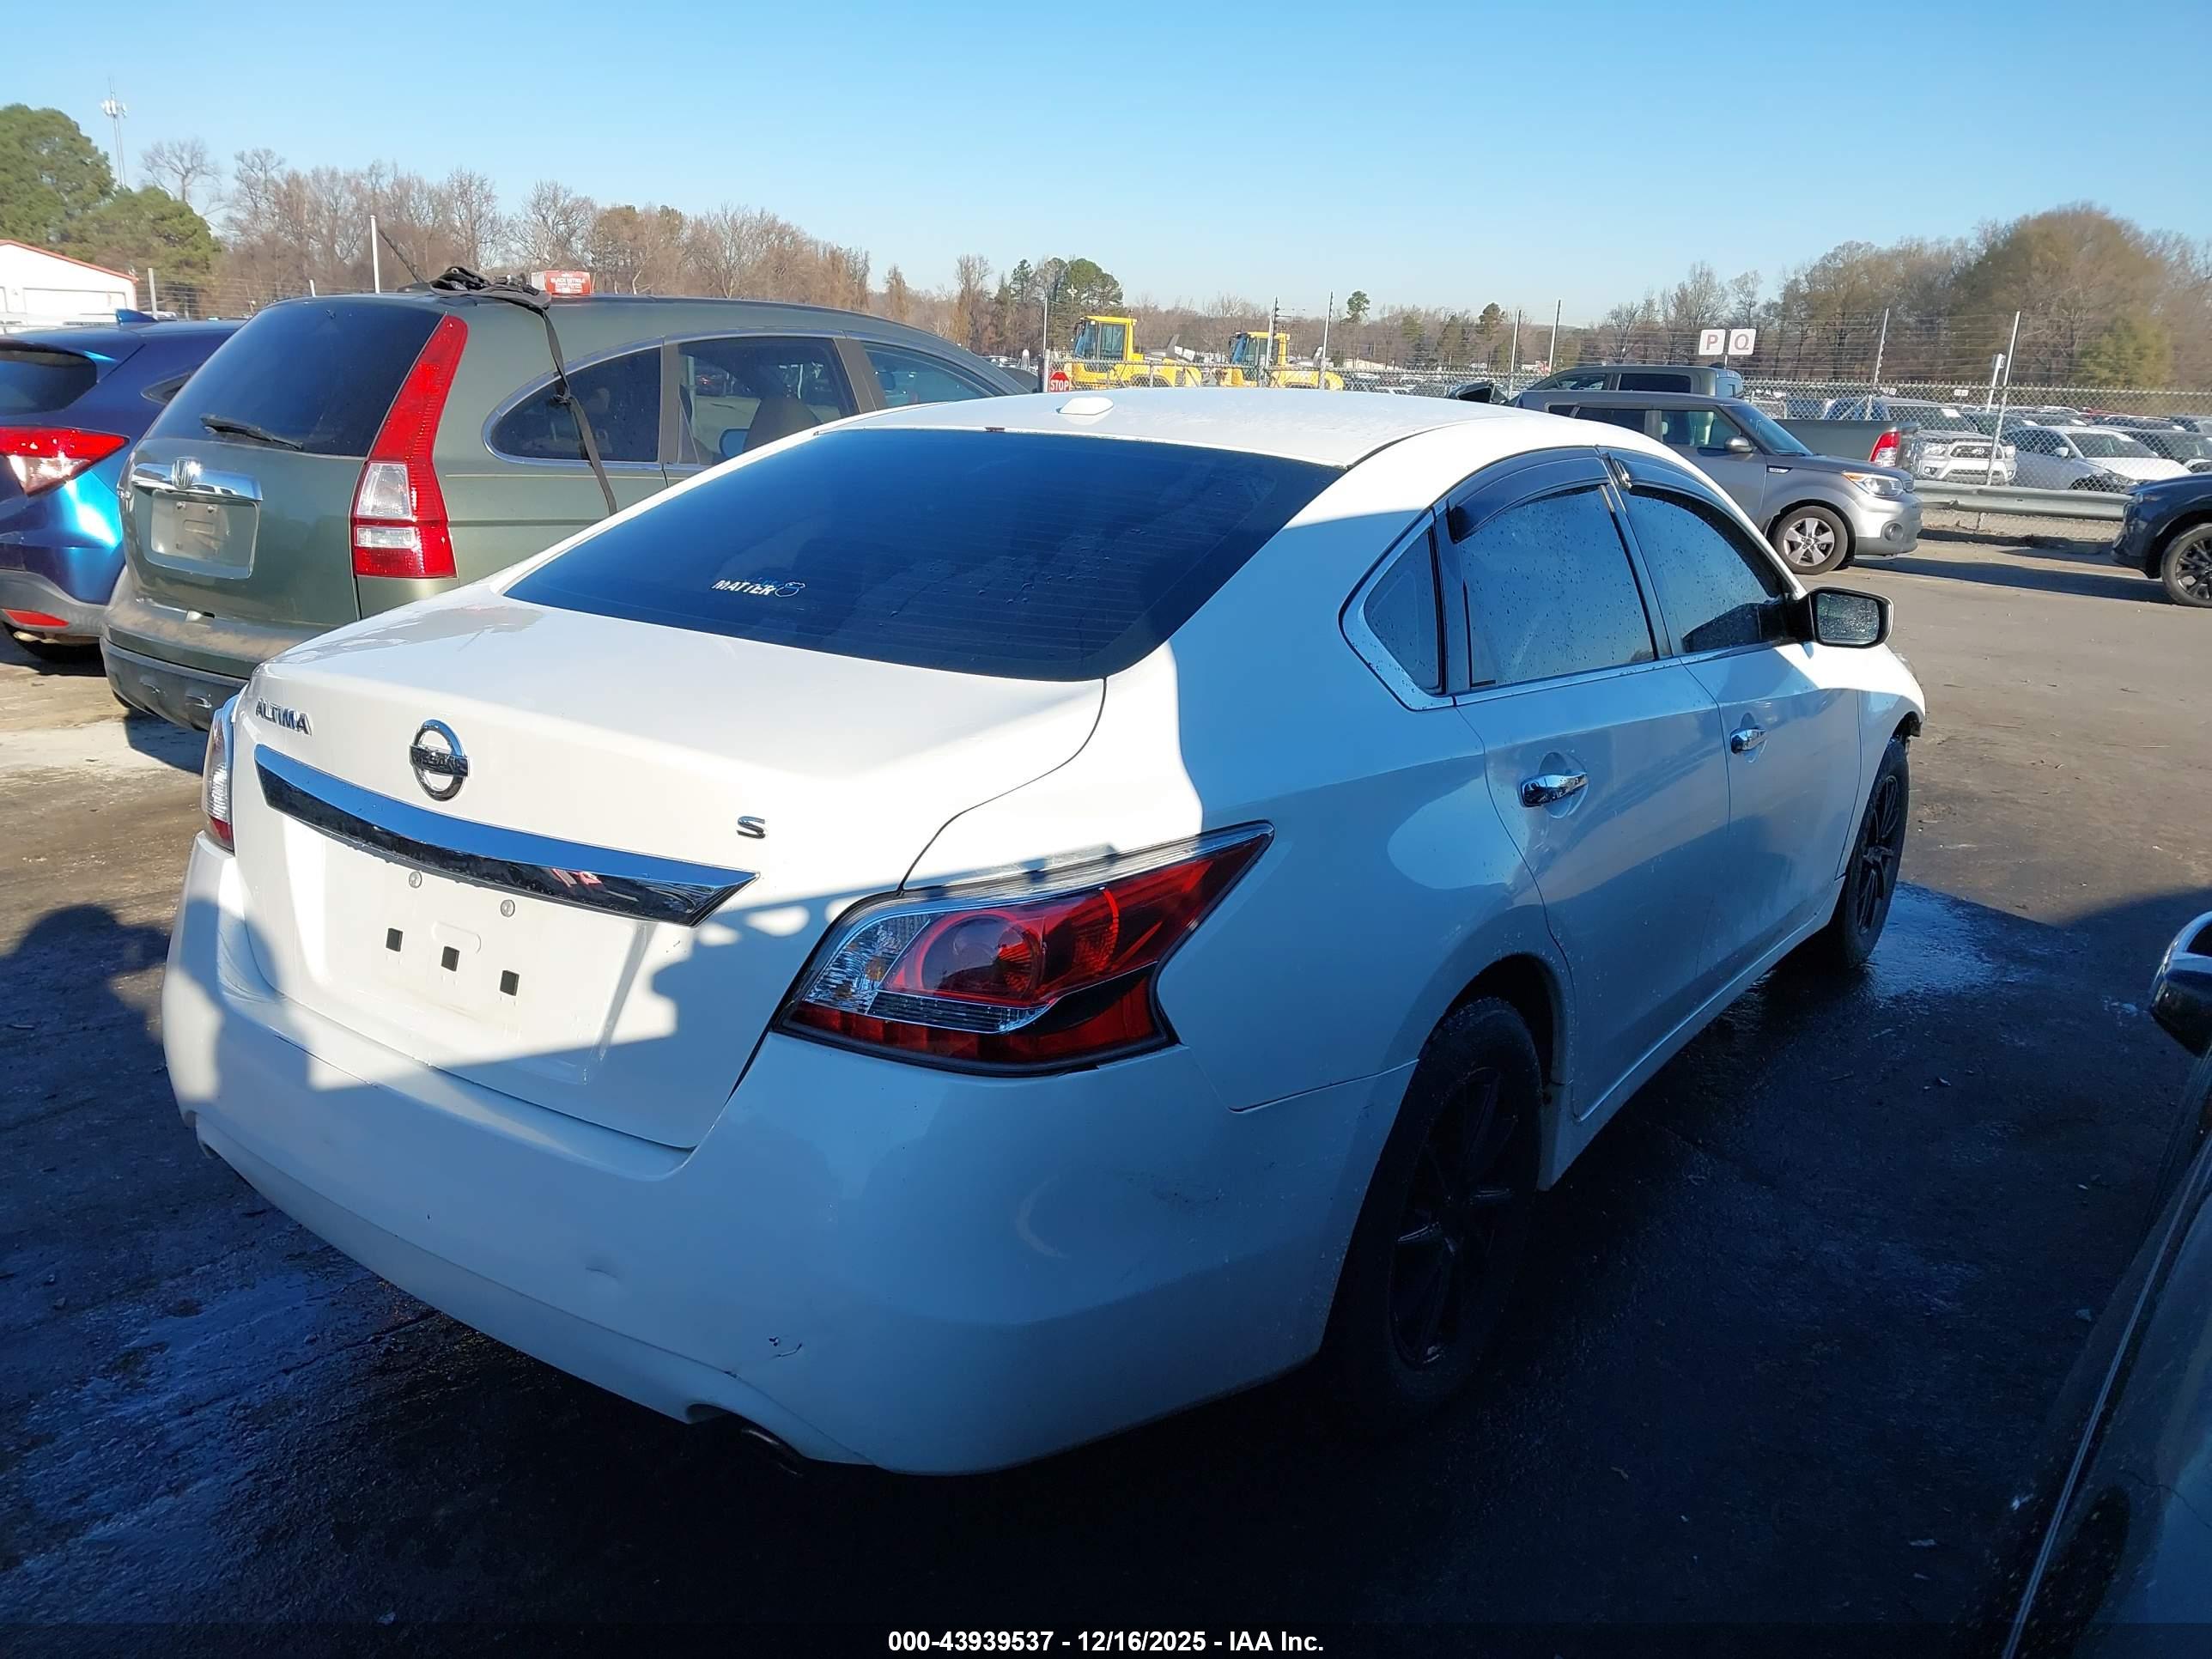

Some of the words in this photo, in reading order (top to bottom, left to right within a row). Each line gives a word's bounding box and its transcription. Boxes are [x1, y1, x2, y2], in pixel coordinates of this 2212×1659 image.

[1705, 334, 1718, 350] P
[1735, 334, 1749, 350] Q
[1050, 380, 1069, 392] STOP
[255, 698, 312, 736] ALTIMA
[736, 816, 766, 839] S
